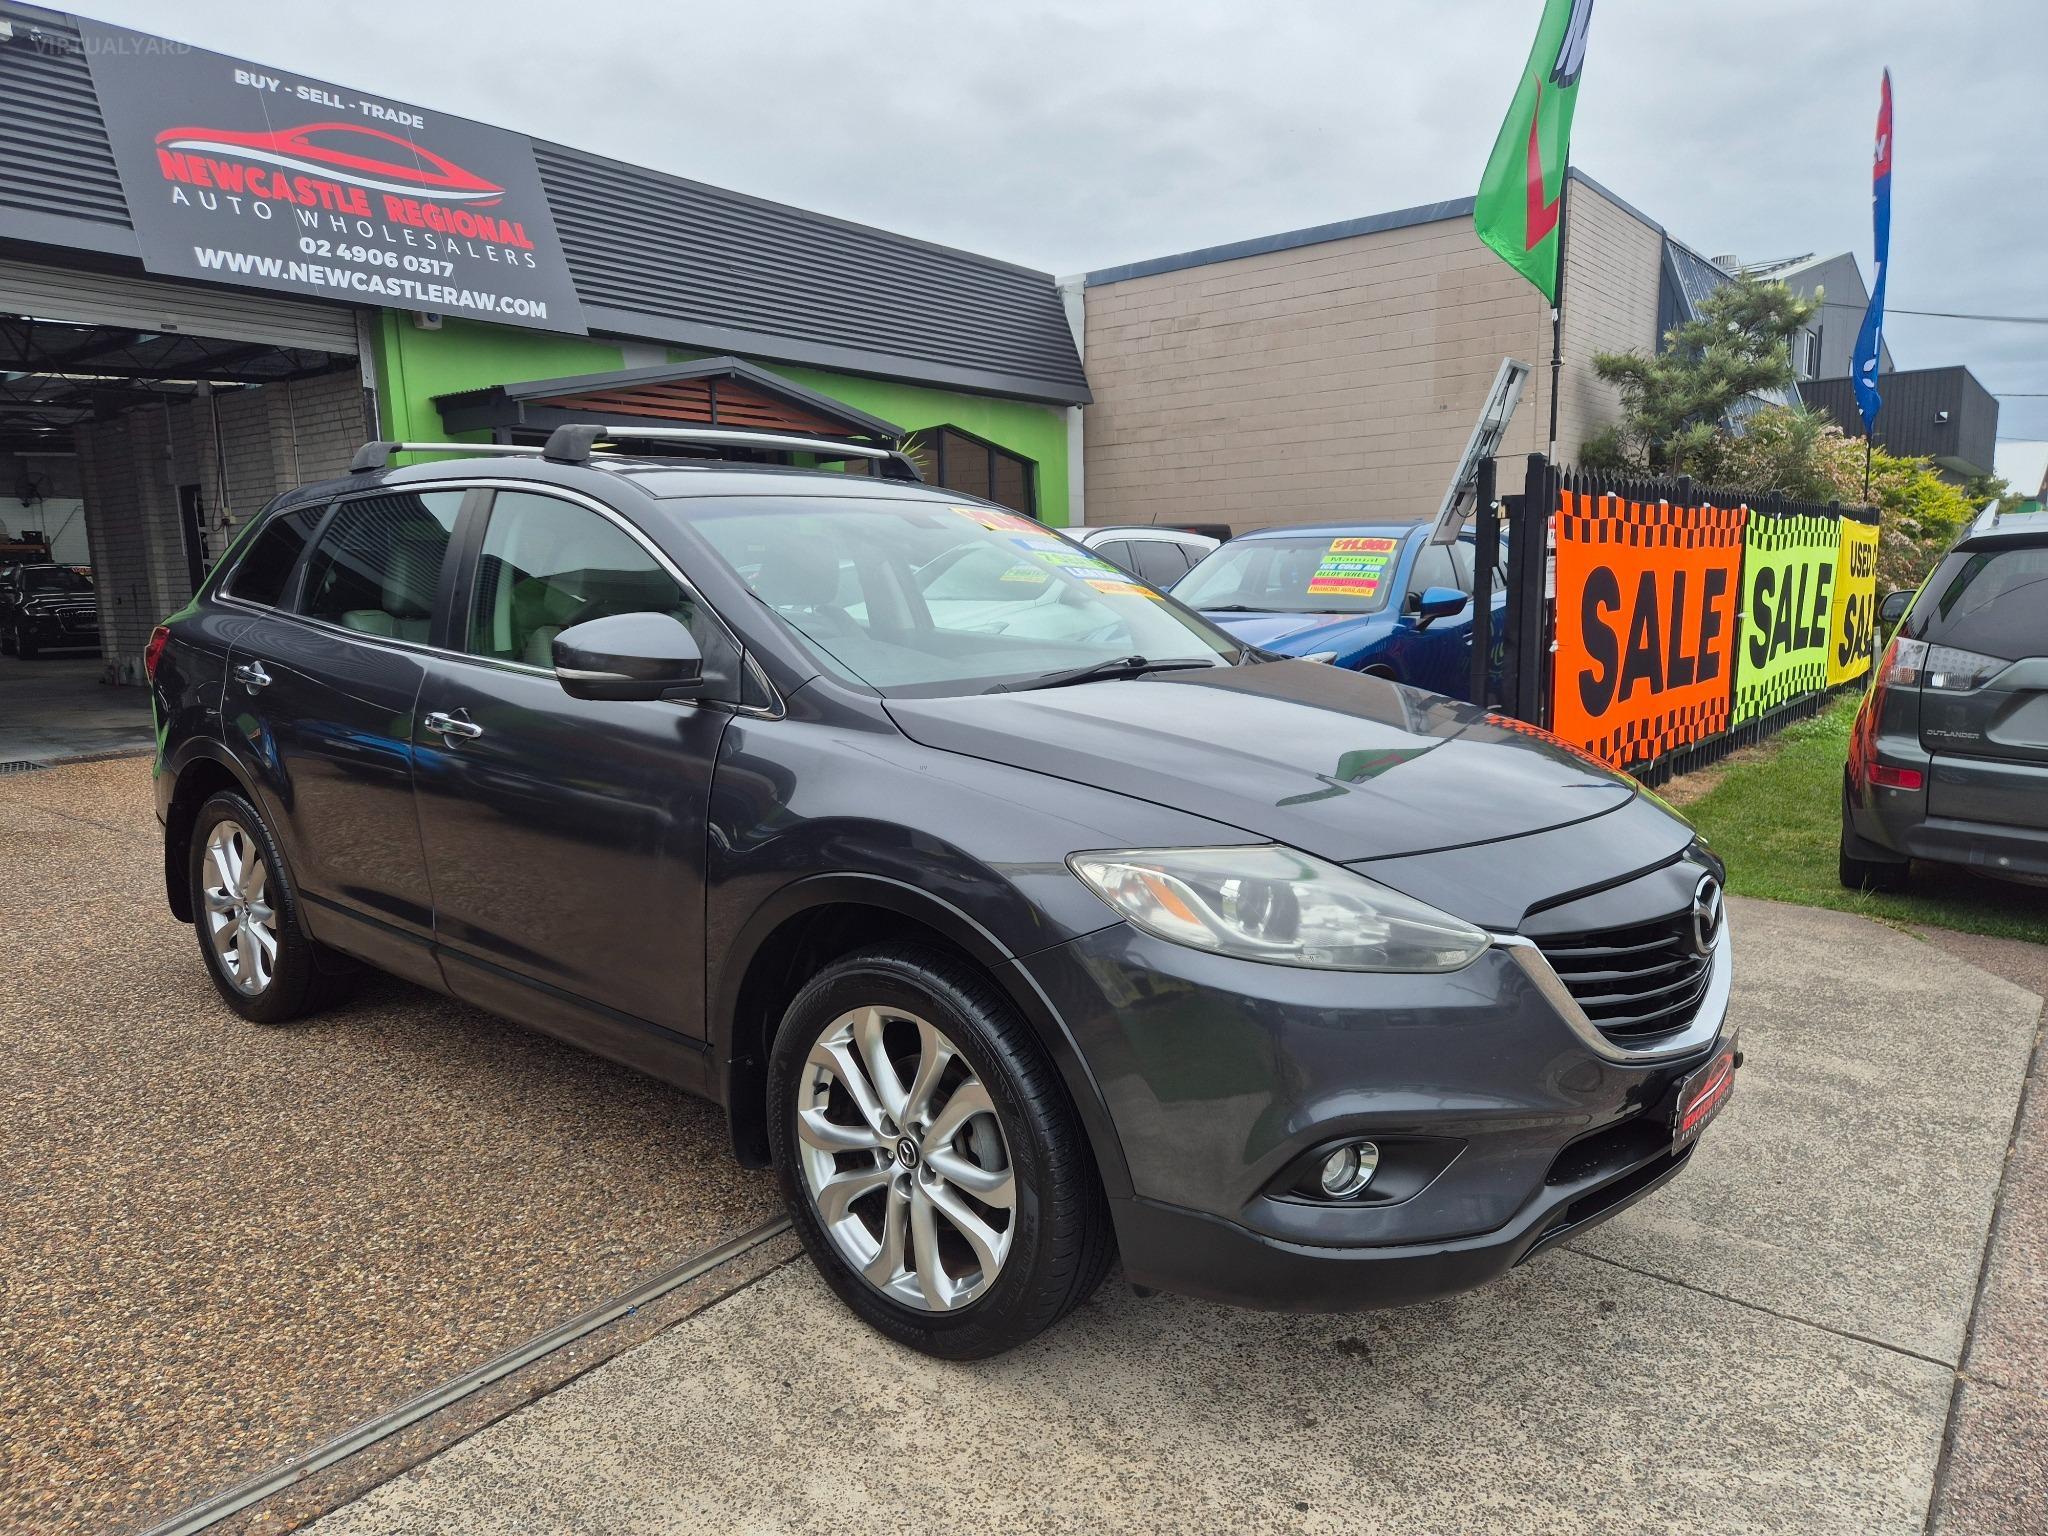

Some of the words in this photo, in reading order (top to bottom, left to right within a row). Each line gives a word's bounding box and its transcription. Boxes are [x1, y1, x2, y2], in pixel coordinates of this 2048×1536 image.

[234, 68, 281, 93] BUY
[296, 85, 345, 109] SELL
[359, 101, 424, 129] TRADE
[156, 148, 373, 218] NEWCASTLE
[383, 194, 535, 250] REGIONAL
[172, 186, 273, 220] AUTO
[296, 208, 537, 269] WHOLESALERS
[193, 245, 548, 320] WWW.NEWCASTLERAW.COM
[299, 236, 332, 258] 02
[336, 243, 399, 269] 4906
[403, 255, 454, 278] 0317
[1344, 571, 1378, 579] WHEELS
[1850, 540, 1873, 578] USED
[1578, 565, 1728, 718] SALE
[1749, 562, 1833, 670] SALE
[1838, 593, 1873, 668] SAL
[1926, 728, 1980, 740] OUTLANDER
